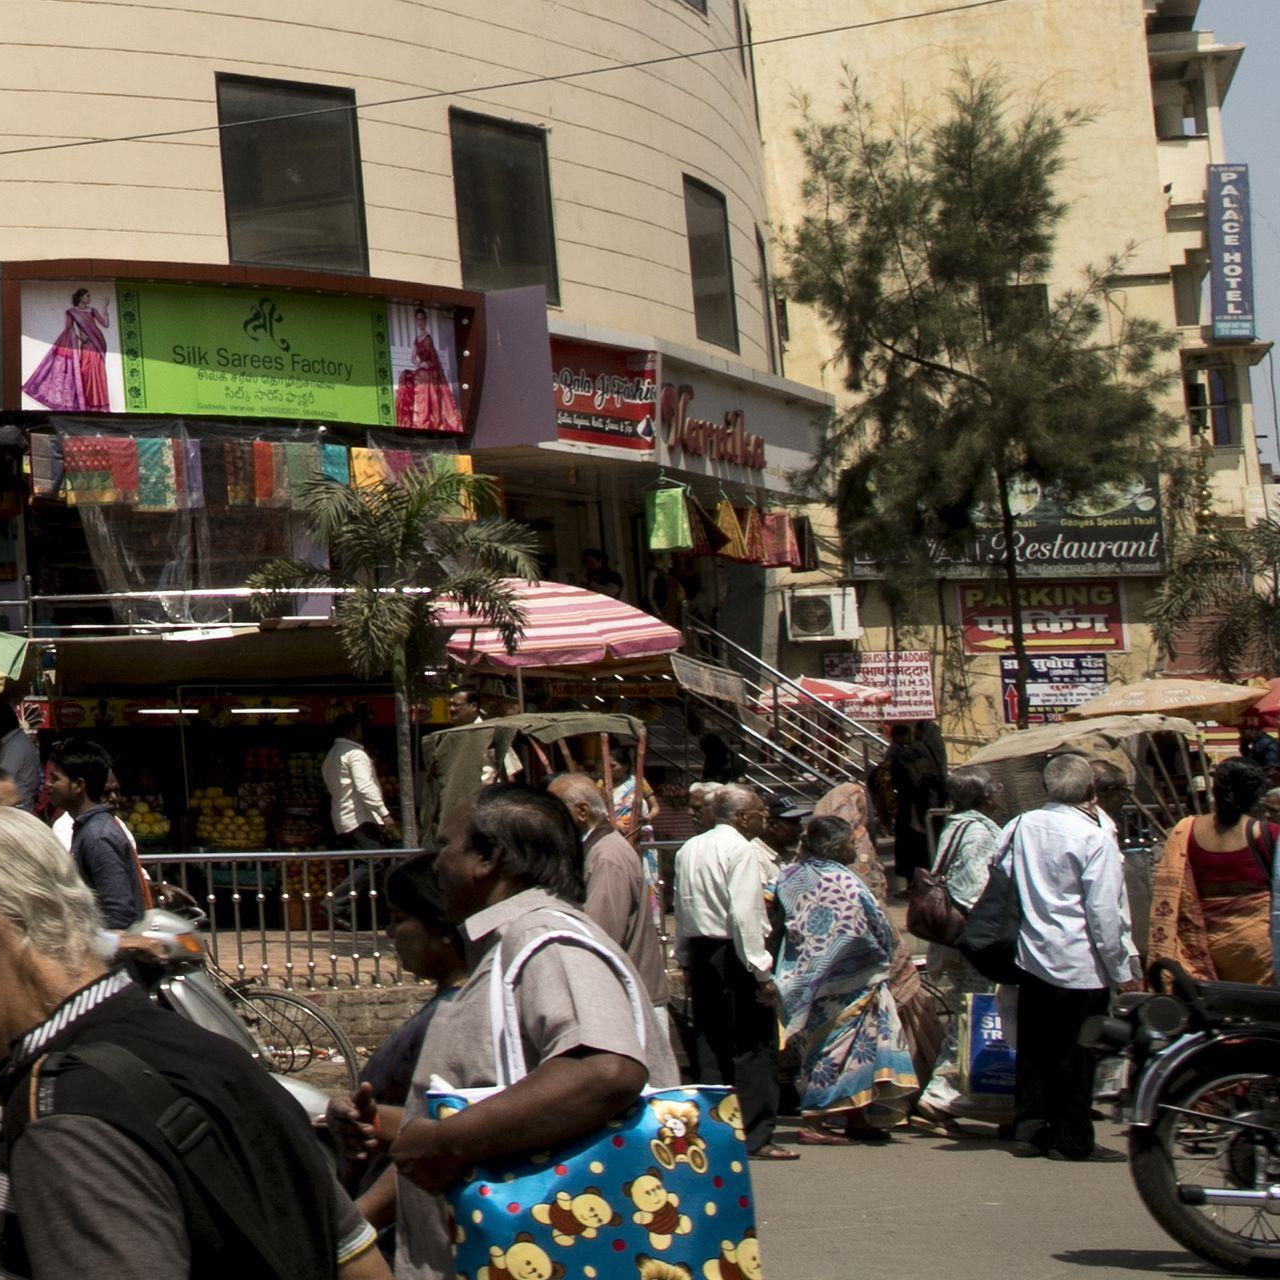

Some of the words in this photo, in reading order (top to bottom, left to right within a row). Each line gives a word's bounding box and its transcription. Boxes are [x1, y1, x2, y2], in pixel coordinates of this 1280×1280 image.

[1220, 172, 1240, 246] PALACE
[1222, 252, 1243, 314] HOTEL
[172, 344, 209, 366] Silk
[216, 347, 284, 371] Sarees
[291, 353, 354, 382] Factory
[986, 530, 1161, 563] Restaurant
